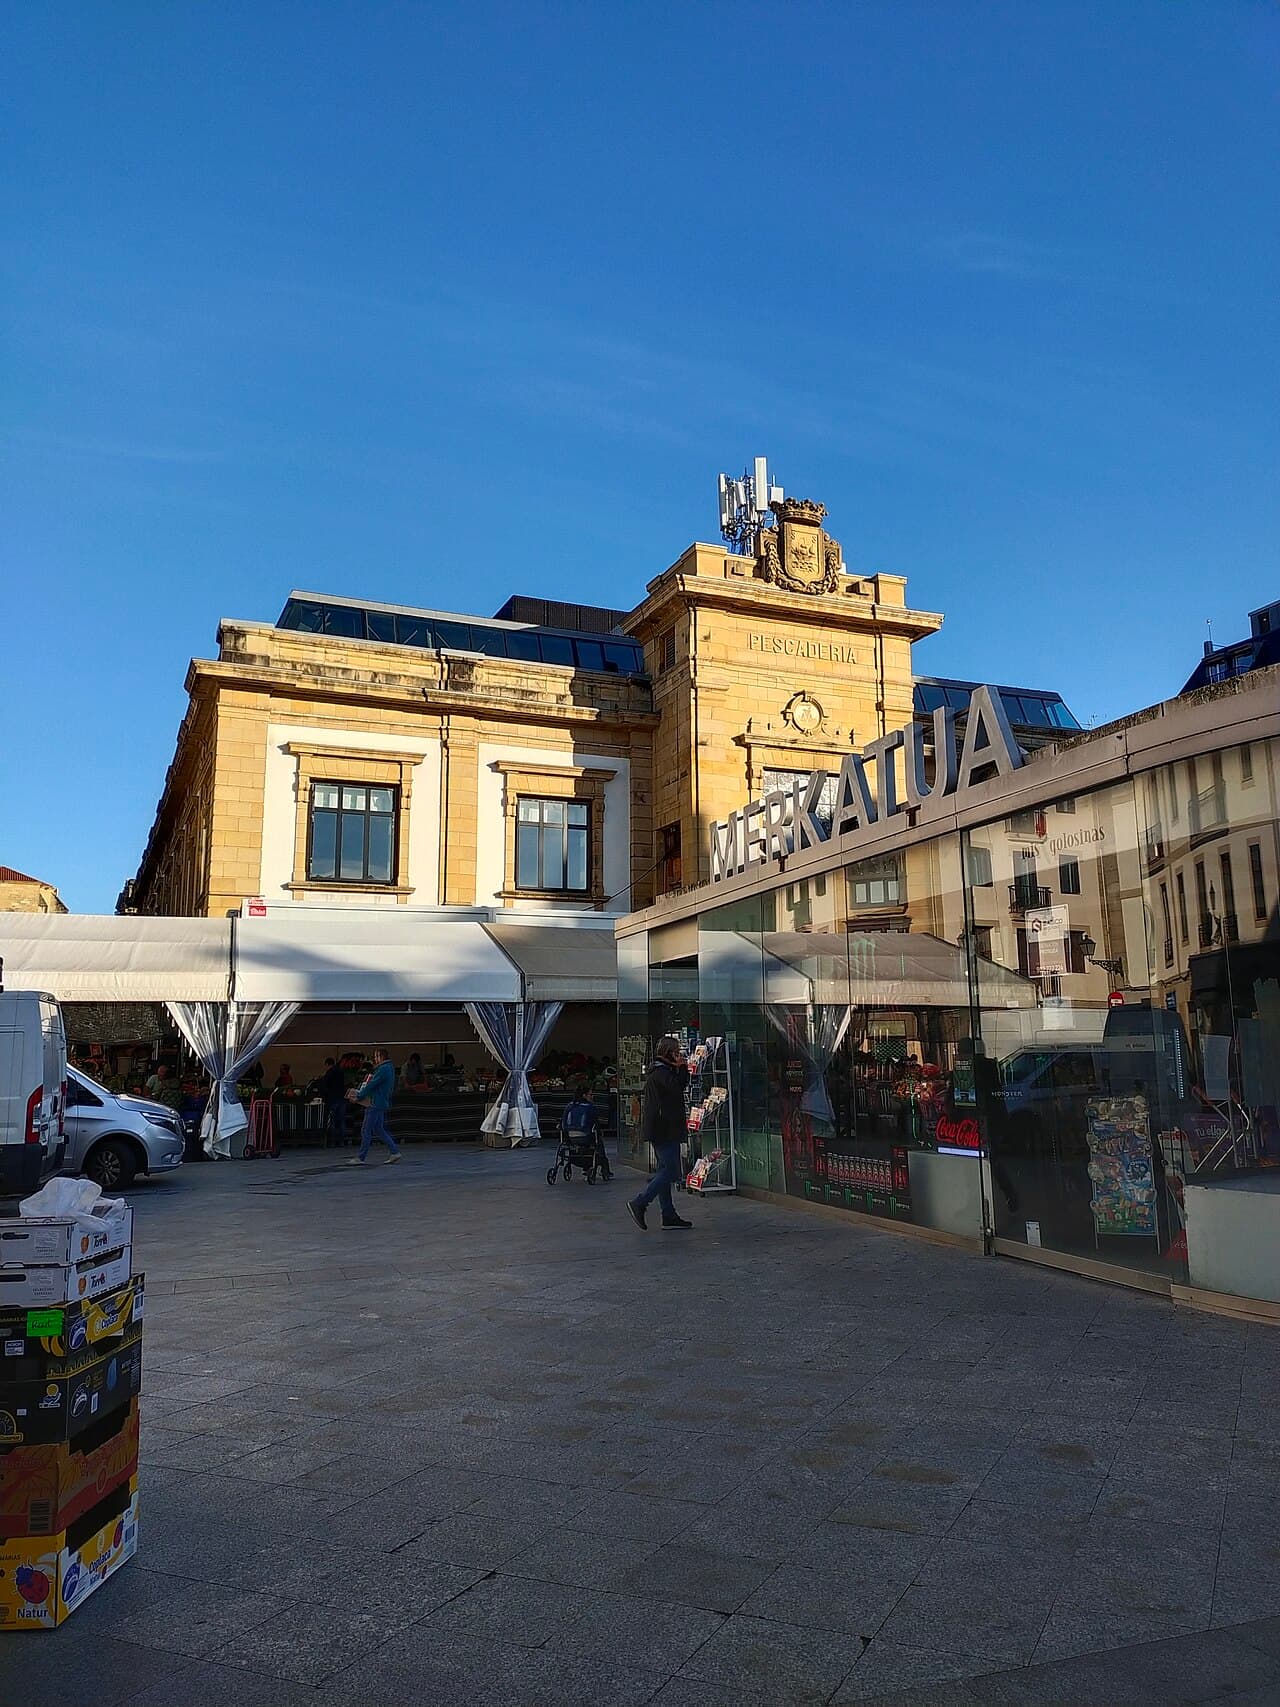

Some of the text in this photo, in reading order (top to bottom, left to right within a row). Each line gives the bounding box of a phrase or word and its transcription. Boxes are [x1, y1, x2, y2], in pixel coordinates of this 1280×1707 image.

[747, 632, 857, 665] PESCADERIA
[709, 685, 1026, 884] MERKATUA
[1022, 825, 1106, 860] mis golosinas
[936, 1115, 980, 1147] Coca-Cola
[17, 1608, 48, 1618] Natur
